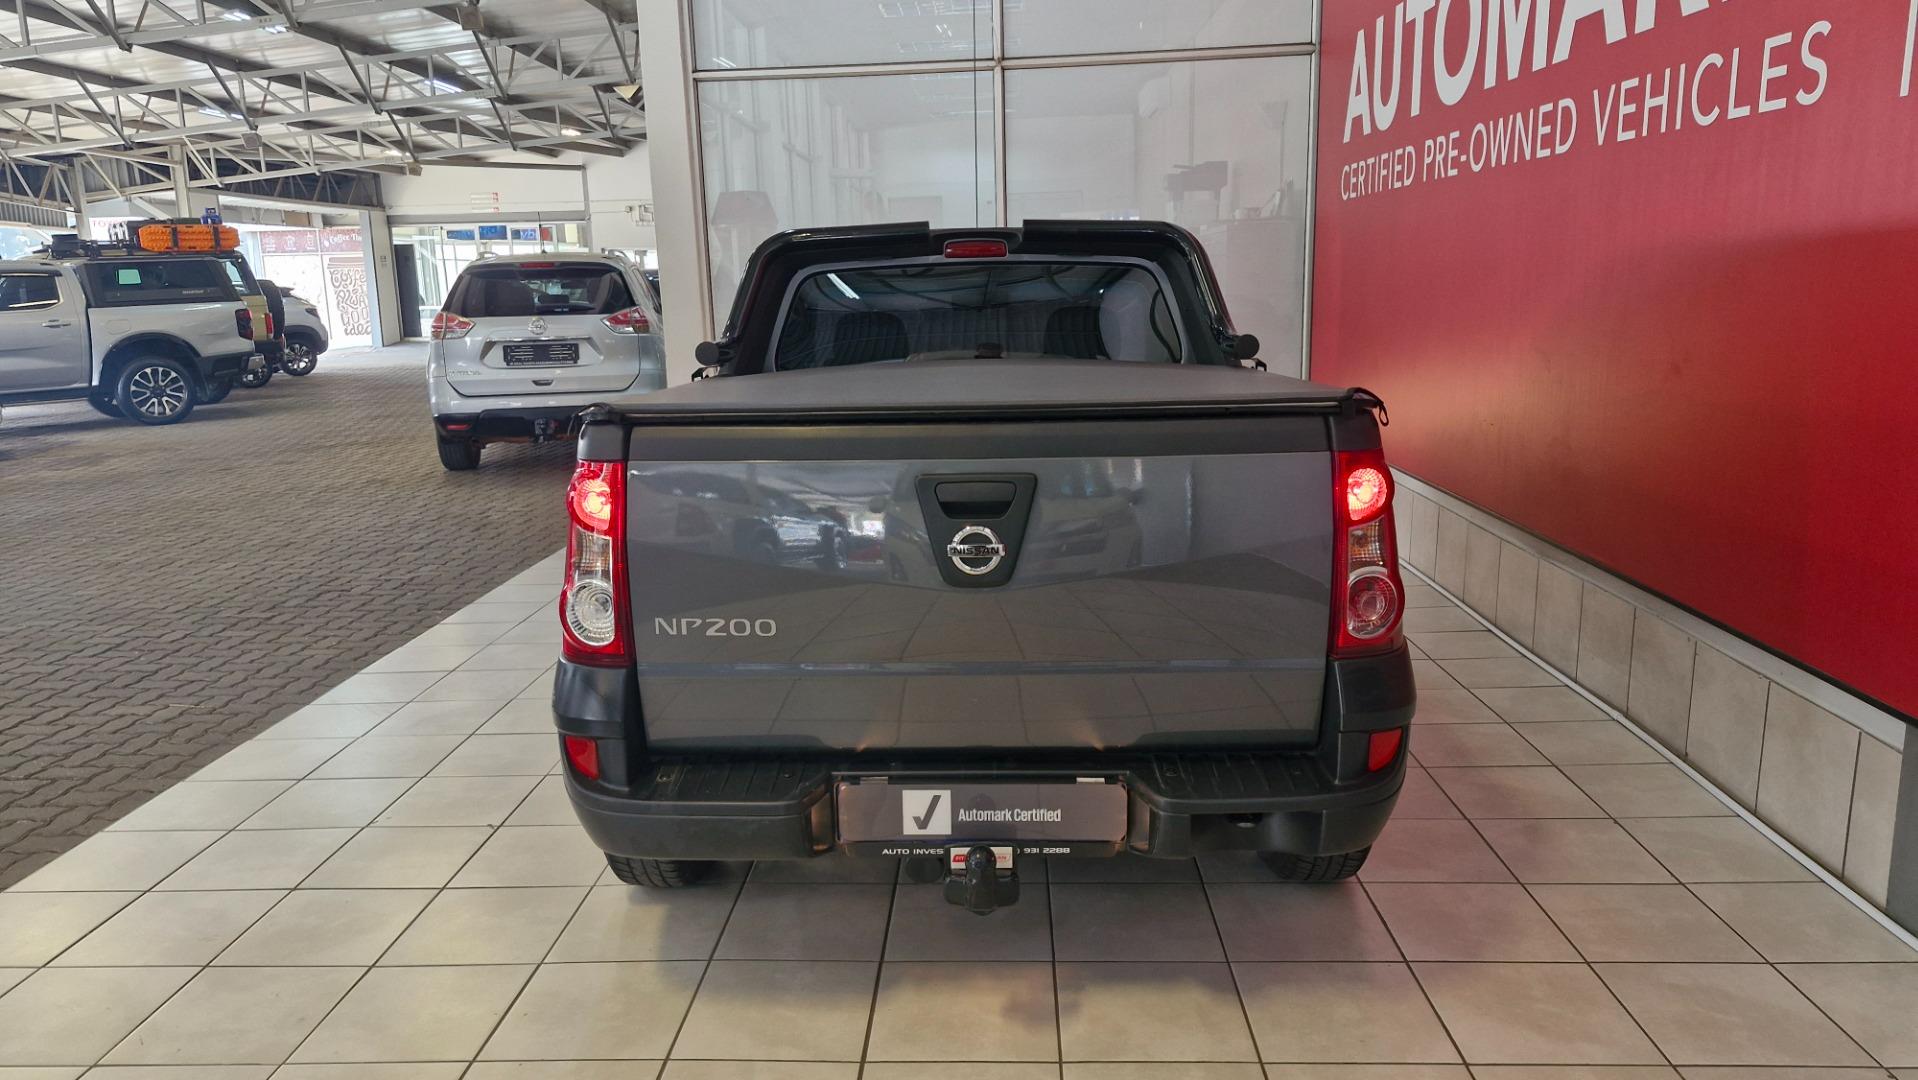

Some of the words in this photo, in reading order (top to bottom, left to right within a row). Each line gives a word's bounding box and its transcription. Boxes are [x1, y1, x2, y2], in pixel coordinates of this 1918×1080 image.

[1340, 146, 1416, 201] CERTIFIED
[1423, 97, 1577, 183] PRE-OWNED
[1593, 20, 1832, 146] VEHICLES
[952, 546, 1000, 556] NISSAN
[654, 617, 777, 637] NP200
[959, 808, 1012, 822] Automark
[1014, 808, 1062, 822] Certified
